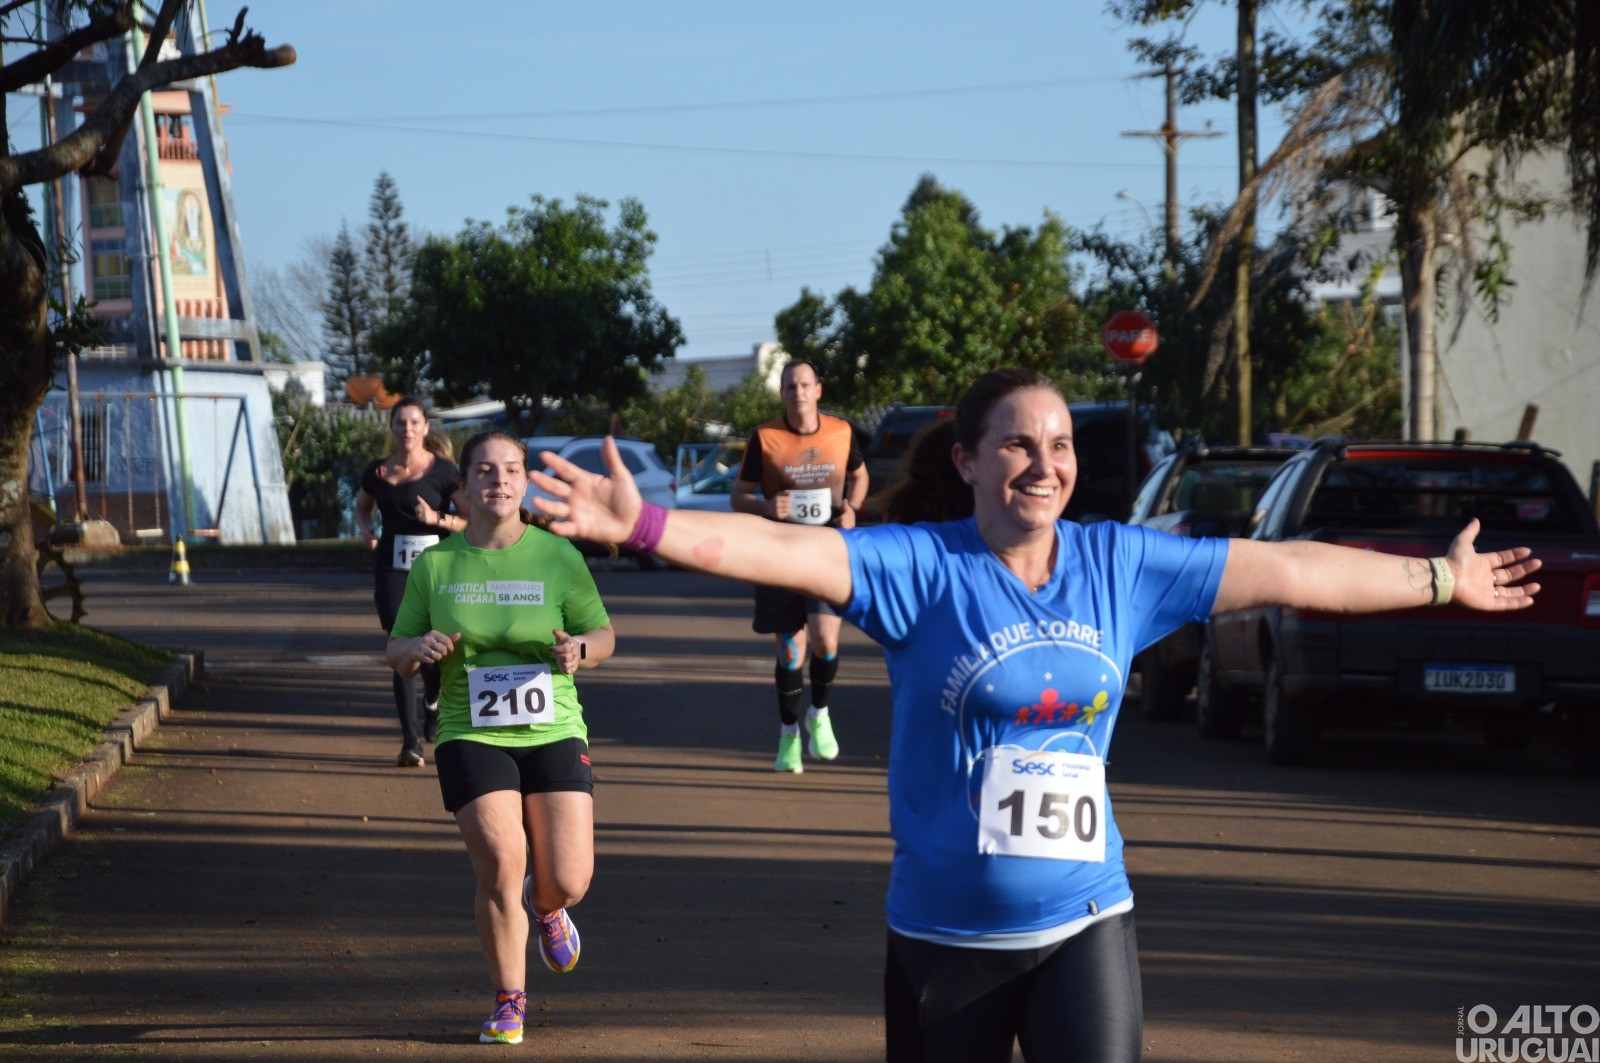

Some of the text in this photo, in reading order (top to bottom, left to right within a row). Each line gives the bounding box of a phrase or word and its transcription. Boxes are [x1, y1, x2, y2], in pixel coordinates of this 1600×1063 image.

[1108, 329, 1151, 342] PARE
[797, 503, 821, 518] 36
[448, 582, 485, 593] RÚSTICA
[490, 583, 541, 591] ANIVERSÁRIO
[455, 594, 541, 606] CAIÇARA 58 ANOS
[941, 620, 1105, 715] FAMÍLIA QUE CORRE
[478, 687, 546, 717] 210
[998, 789, 1098, 842] 150
